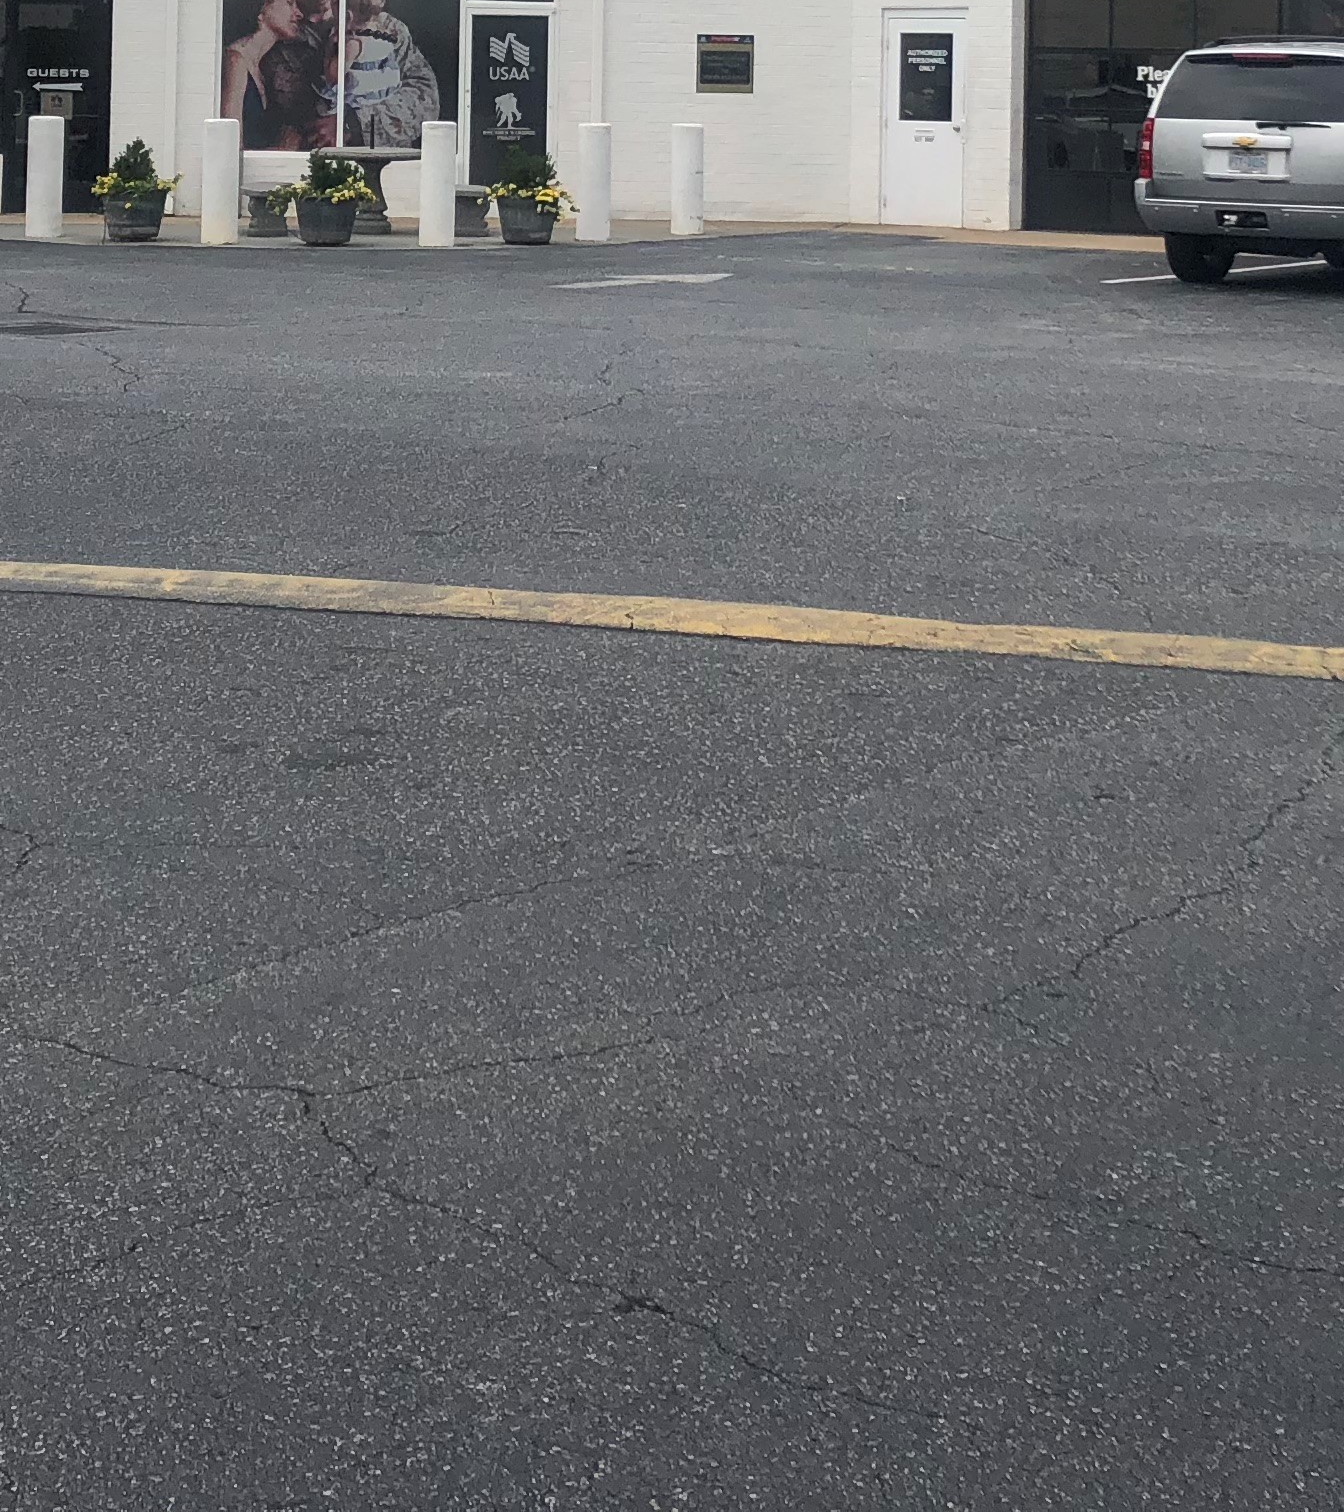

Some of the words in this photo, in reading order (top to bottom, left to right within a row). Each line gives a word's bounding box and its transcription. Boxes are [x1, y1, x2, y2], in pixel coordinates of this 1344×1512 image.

[27, 68, 90, 78] GUESTS
[489, 66, 530, 81] USAA
[1136, 66, 1170, 81] Plea
